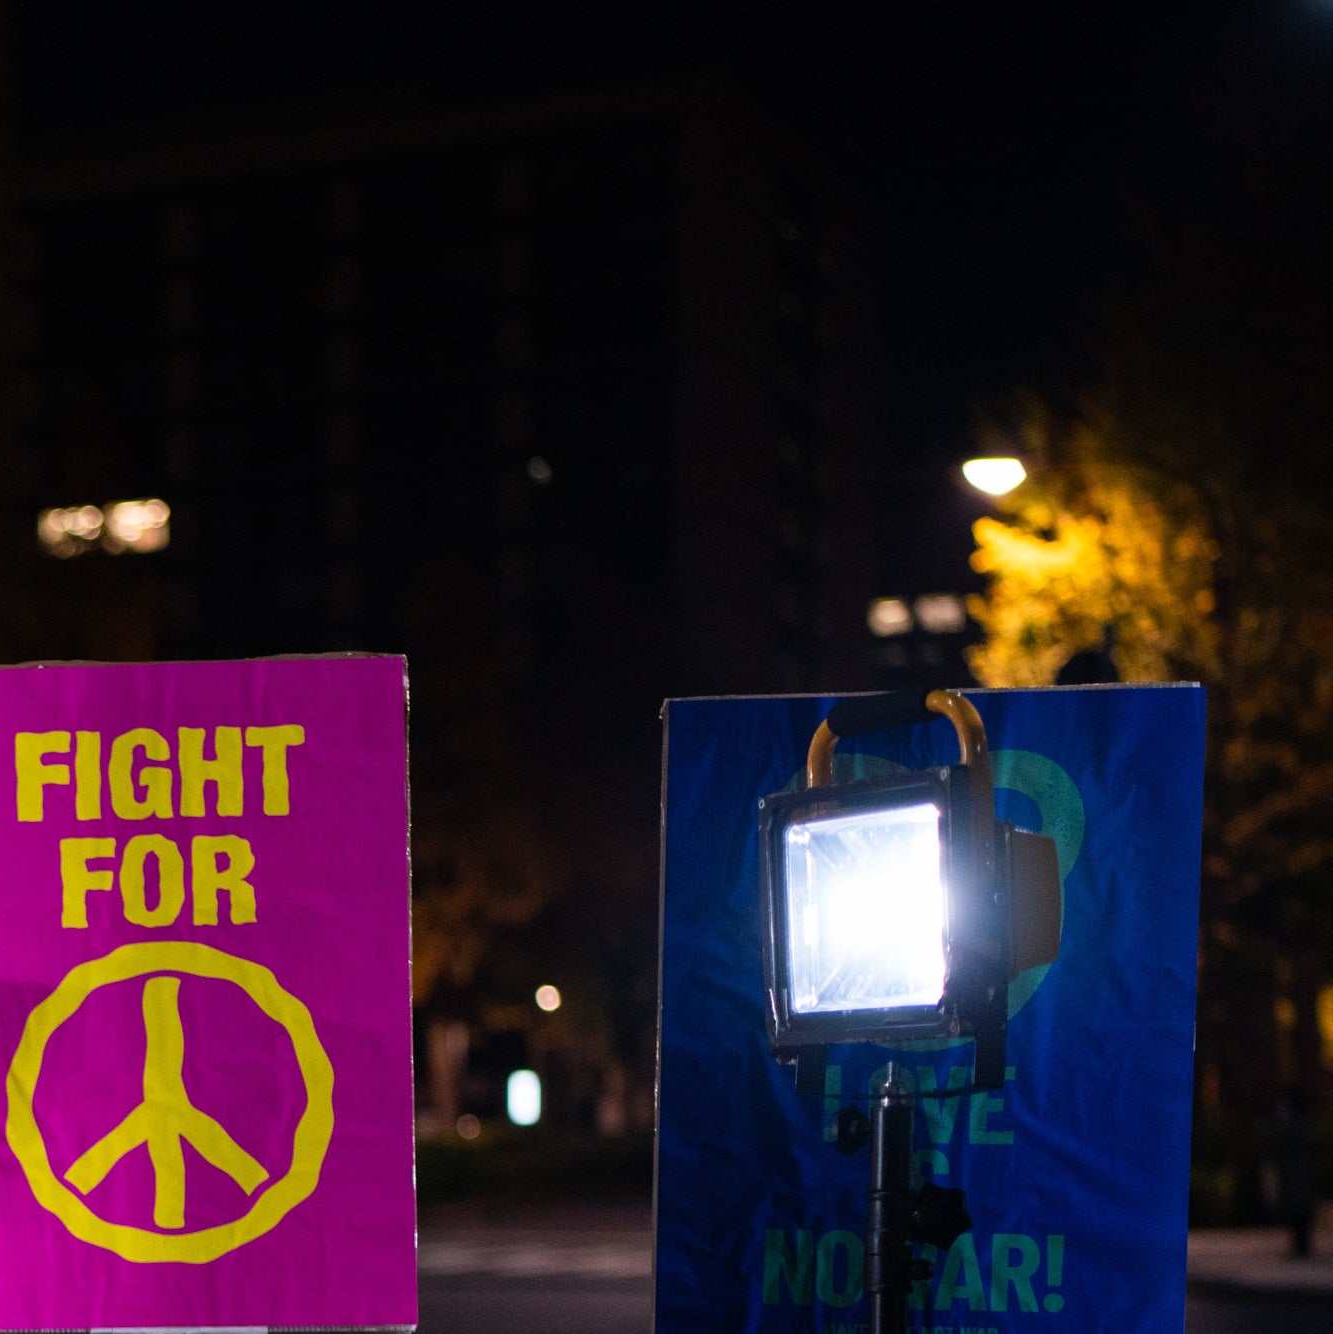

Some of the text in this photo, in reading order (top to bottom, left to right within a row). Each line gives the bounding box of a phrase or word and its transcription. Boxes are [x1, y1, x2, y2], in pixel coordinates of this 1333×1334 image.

[14, 723, 305, 822] FIGHT
[59, 832, 257, 929] FOR
[763, 1228, 867, 1308] NO
